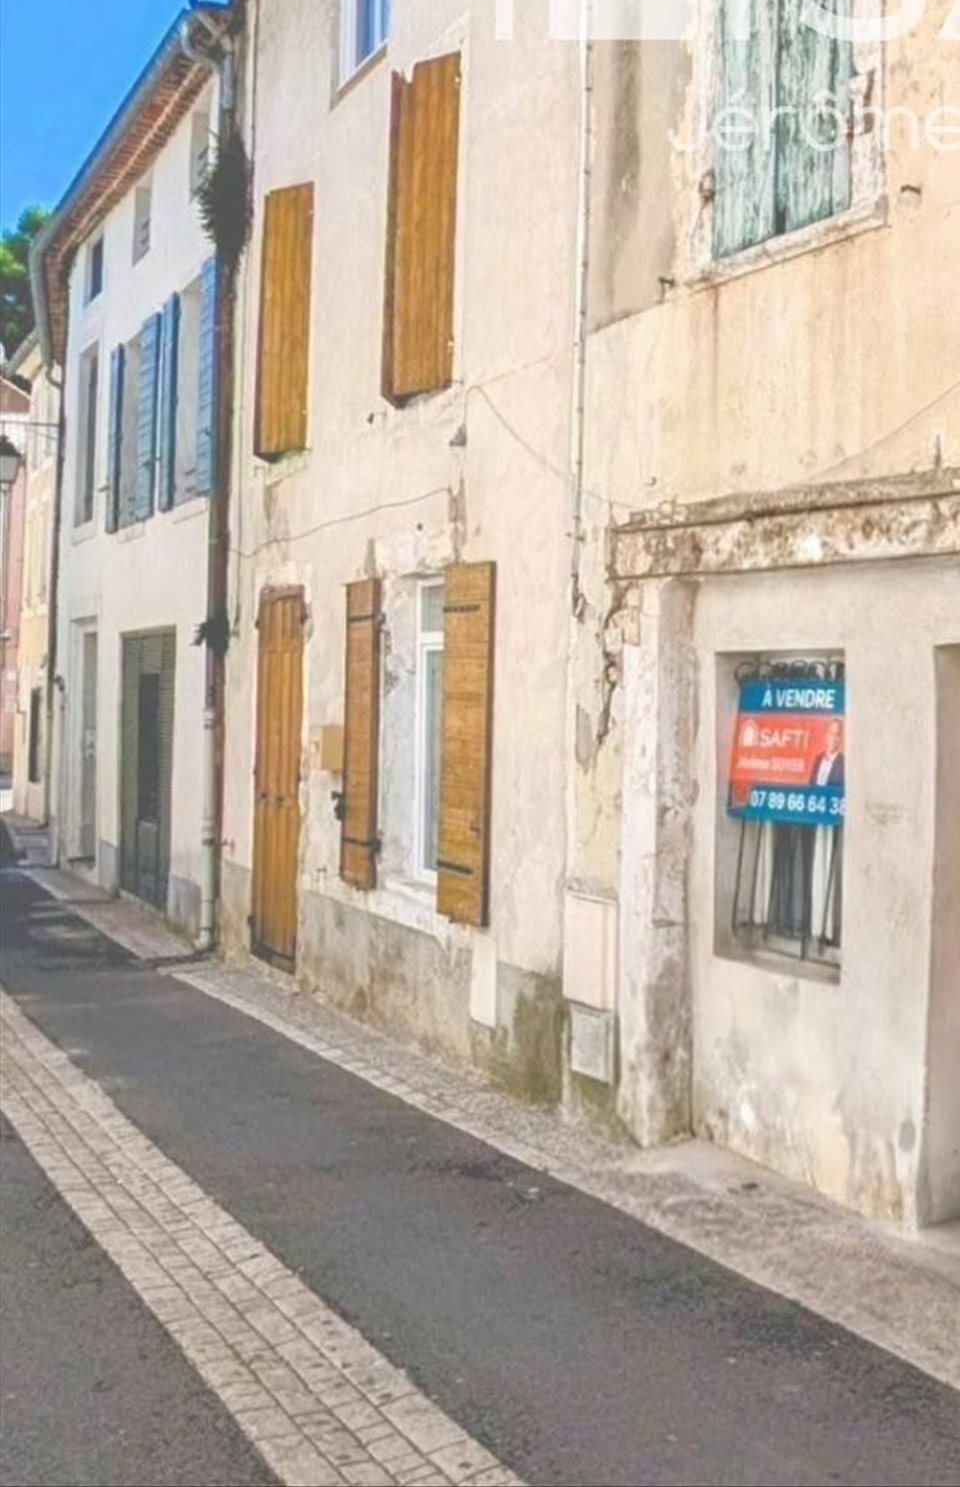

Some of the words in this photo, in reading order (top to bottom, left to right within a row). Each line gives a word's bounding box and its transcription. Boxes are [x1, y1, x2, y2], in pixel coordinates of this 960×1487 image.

[776, 688, 836, 709] VENDRE
[750, 790, 767, 808] 07
[787, 793, 806, 811] 66
[807, 795, 827, 813] 64
